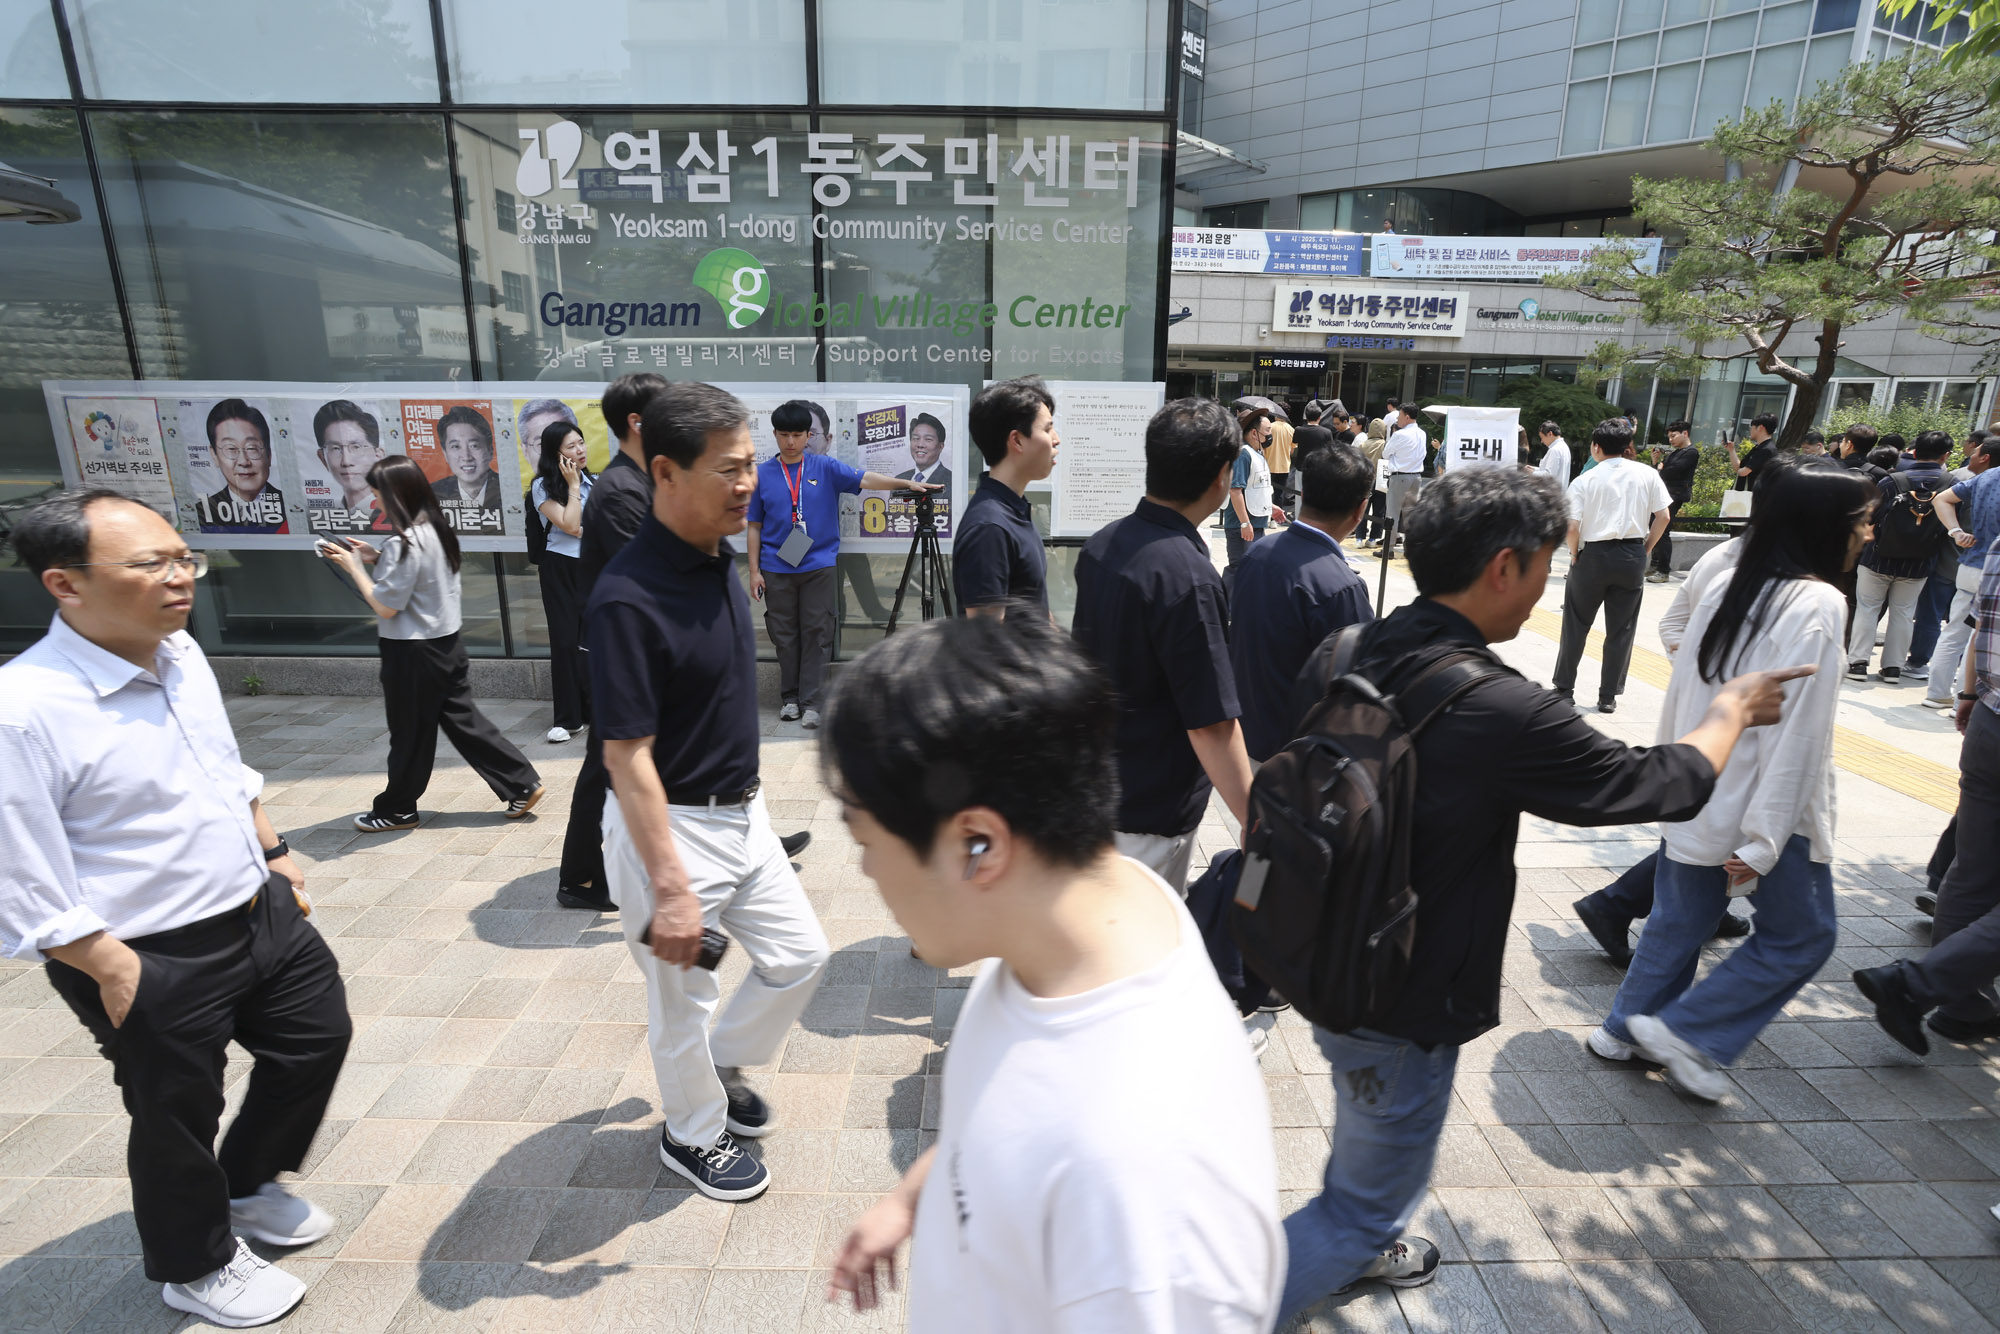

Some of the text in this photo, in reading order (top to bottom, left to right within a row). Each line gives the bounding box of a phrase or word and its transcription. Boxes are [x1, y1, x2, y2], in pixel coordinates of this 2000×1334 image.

[1181, 30, 1205, 63] 센터
[1181, 59, 1202, 77] Complex
[604, 129, 1139, 207] 역삼1동주민센터
[515, 204, 593, 230] 강남구
[609, 212, 1133, 244] Yeoksam 1-dong Community Service Center
[576, 235, 591, 244] GU
[1197, 233, 1213, 244] 거점
[1200, 248, 1225, 259] 교환해
[1227, 249, 1260, 260] 드립니다
[1404, 248, 1426, 260] 세탁
[1428, 248, 1438, 260] 및
[1442, 248, 1452, 260] 짐
[1456, 248, 1476, 260] 보관
[1479, 249, 1510, 260] 서비스
[1517, 249, 1579, 261] 동주민센터로
[540, 291, 701, 336] Gangnam
[872, 293, 998, 337] Village
[1008, 295, 1131, 329] Center
[1318, 293, 1457, 319] 역삼1동주민센터
[1288, 314, 1313, 324] 강남구
[1318, 318, 1453, 331] Yeoksam 1-dong Community Service Center
[1477, 308, 1519, 321] Gangnam
[1562, 312, 1594, 324] Village
[1340, 336, 1394, 350] 역삼로7길
[543, 343, 796, 368] 강남글로벌빌리지센터
[828, 344, 918, 366] Support
[926, 344, 1001, 363] Center
[1010, 345, 1039, 363] for
[1050, 346, 1124, 366] Expats
[1259, 359, 1273, 367] 365
[405, 405, 444, 419] 미래를
[865, 409, 899, 427] 선경제,
[406, 420, 432, 434] 여는
[865, 423, 900, 441] 후정치!
[409, 435, 436, 449] 선택
[1459, 438, 1502, 461] 관내
[85, 462, 163, 474] 선거벽보 주의문
[260, 492, 280, 500] 지금은
[217, 501, 284, 524] 이재명
[310, 510, 371, 530] 김문수
[441, 509, 502, 530] 이준석
[864, 497, 886, 533] 8
